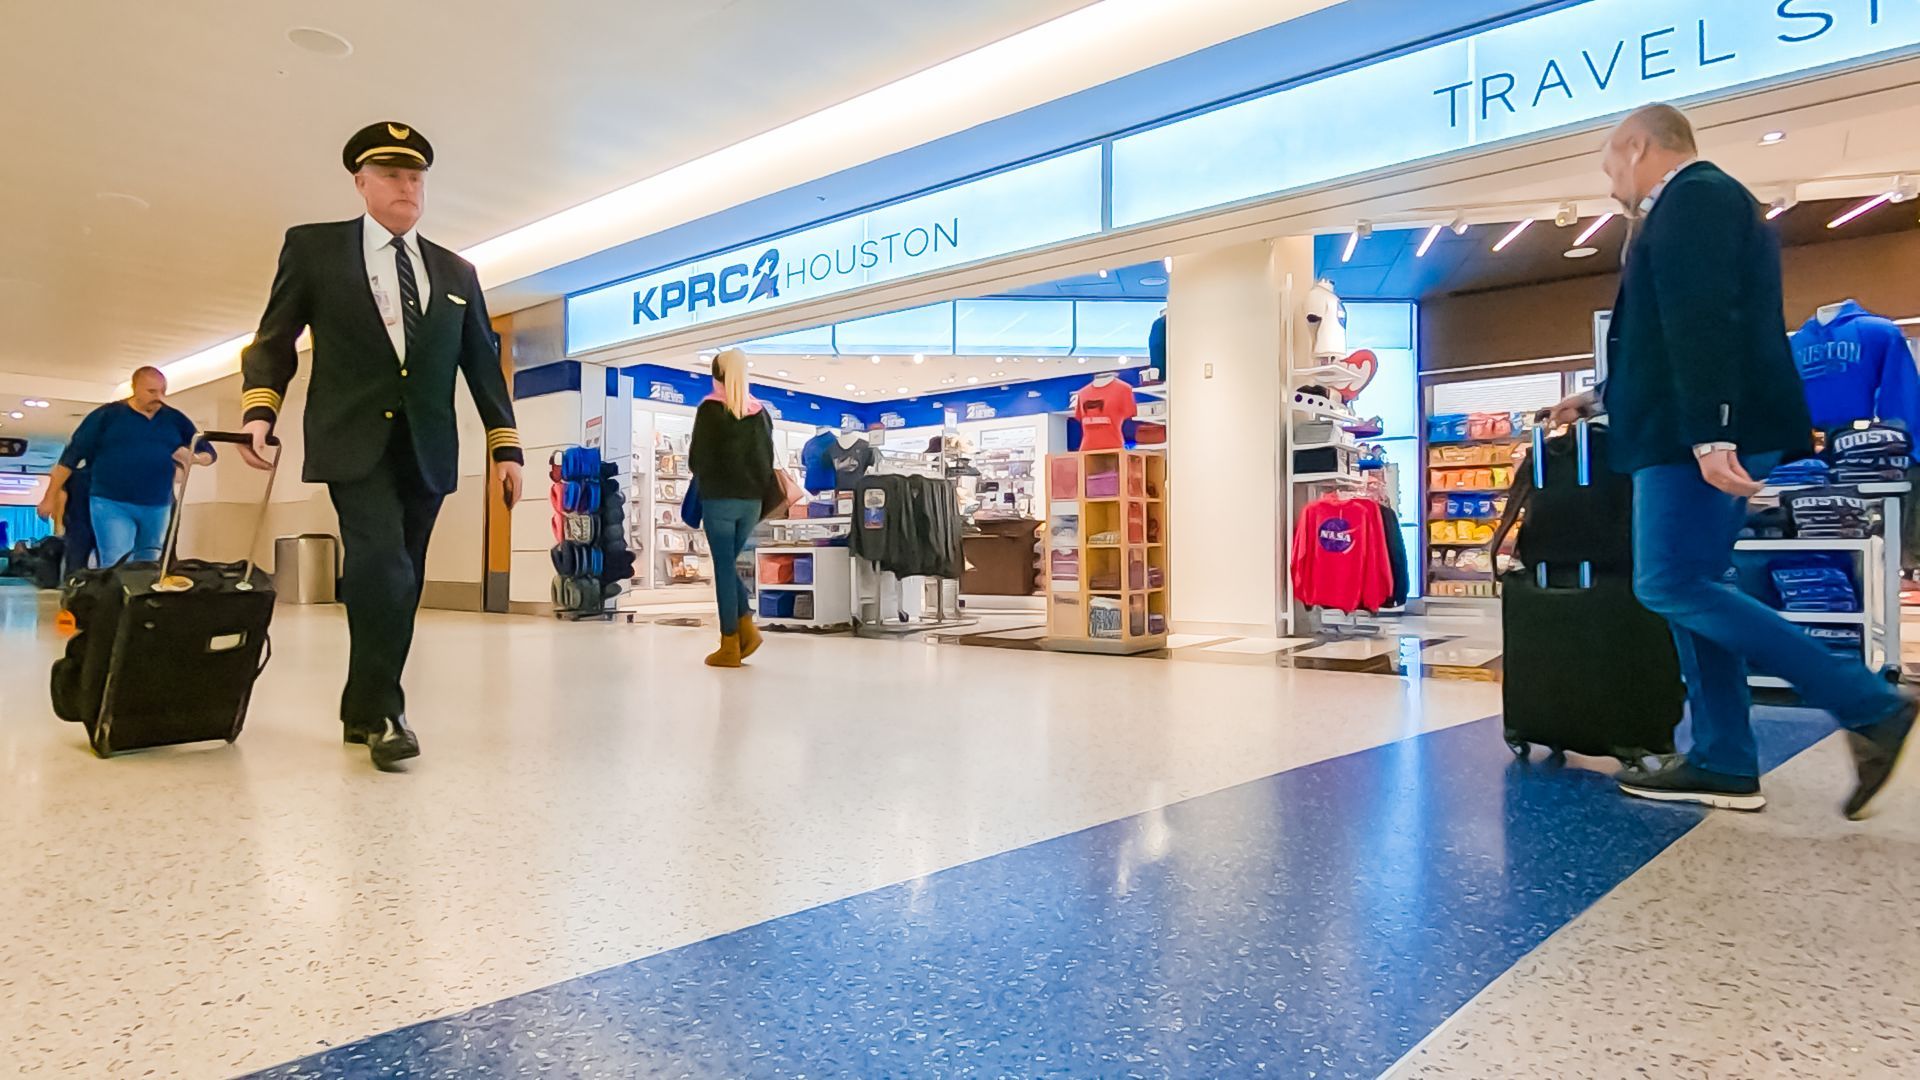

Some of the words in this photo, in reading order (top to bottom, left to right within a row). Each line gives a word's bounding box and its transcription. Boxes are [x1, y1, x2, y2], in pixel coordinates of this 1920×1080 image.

[1433, 19, 1736, 128] TRAVEL
[786, 217, 959, 289] HOUSTON
[1320, 530, 1352, 542] NASA
